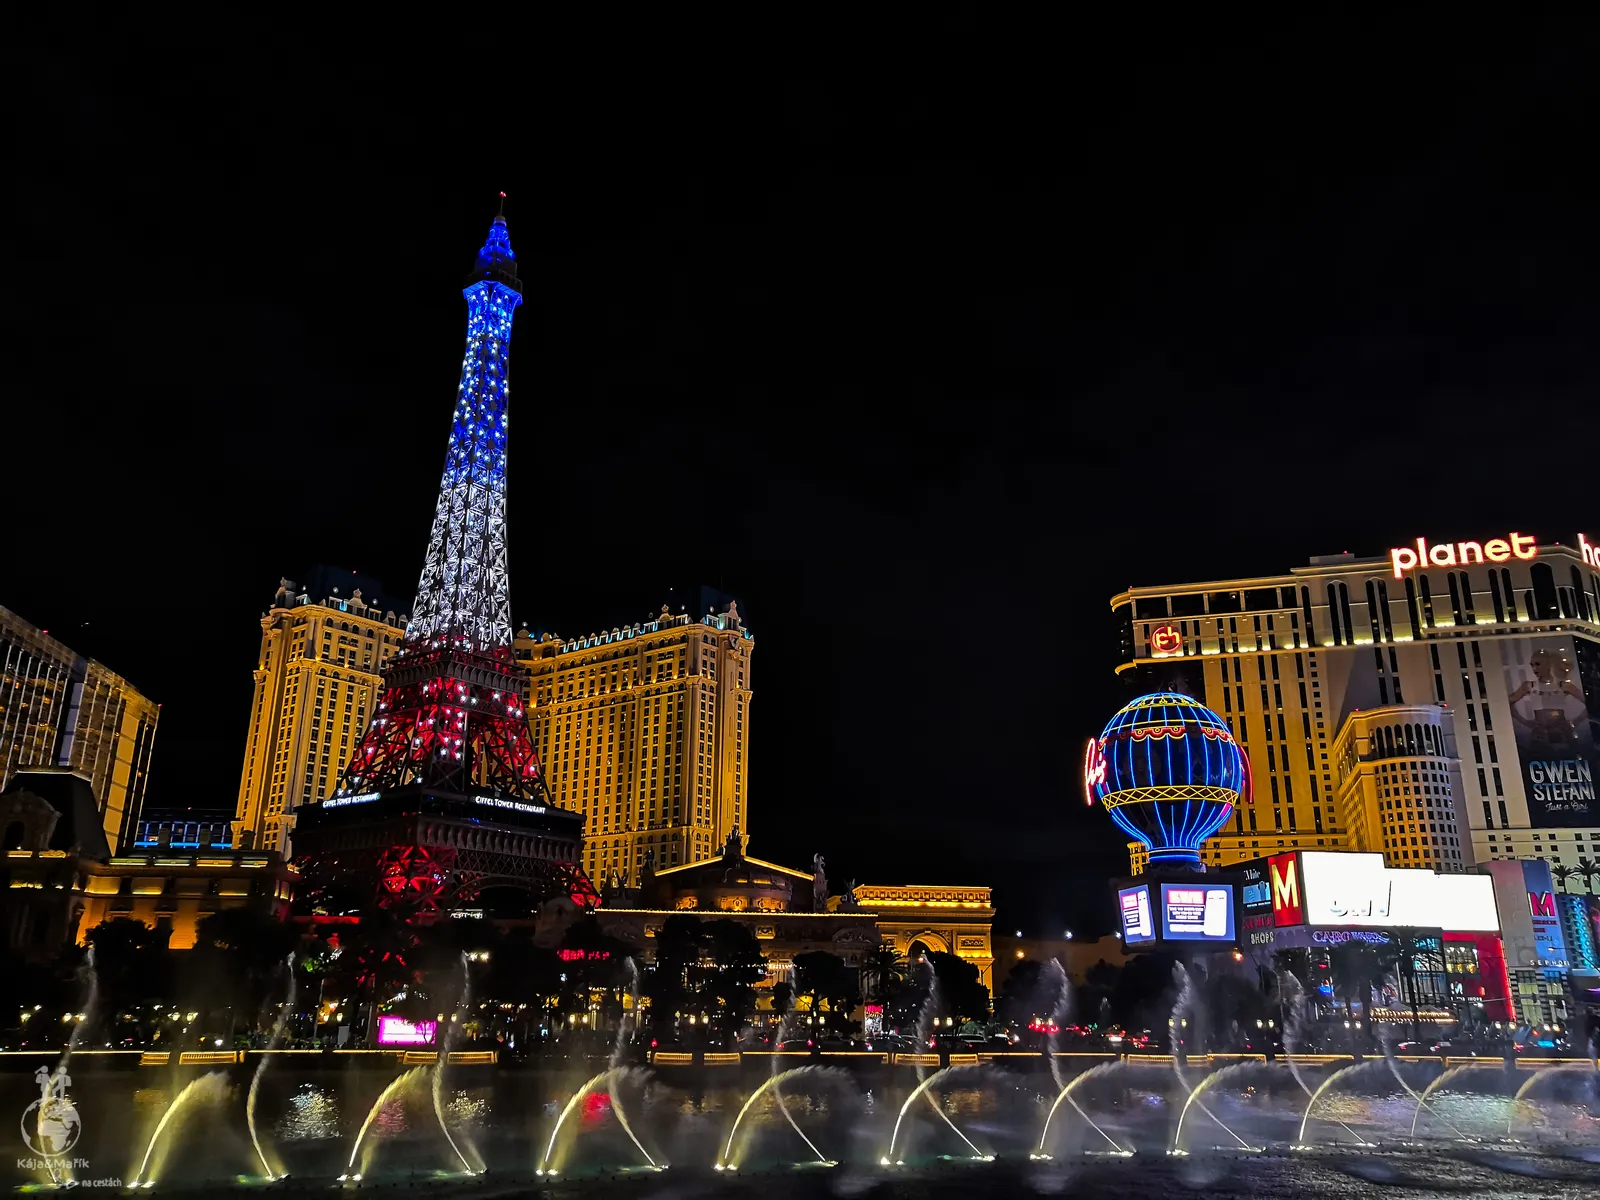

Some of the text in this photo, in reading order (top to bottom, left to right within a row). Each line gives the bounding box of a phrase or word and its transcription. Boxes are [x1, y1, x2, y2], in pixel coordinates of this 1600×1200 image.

[1391, 532, 1538, 579] planet
[1156, 626, 1180, 648] ph
[1529, 760, 1592, 784] GWEN
[1533, 782, 1596, 801] STEFANI
[475, 795, 546, 814] EIFFEL TOWER RESTAURANT
[1271, 860, 1299, 911] M
[1528, 891, 1556, 917] M
